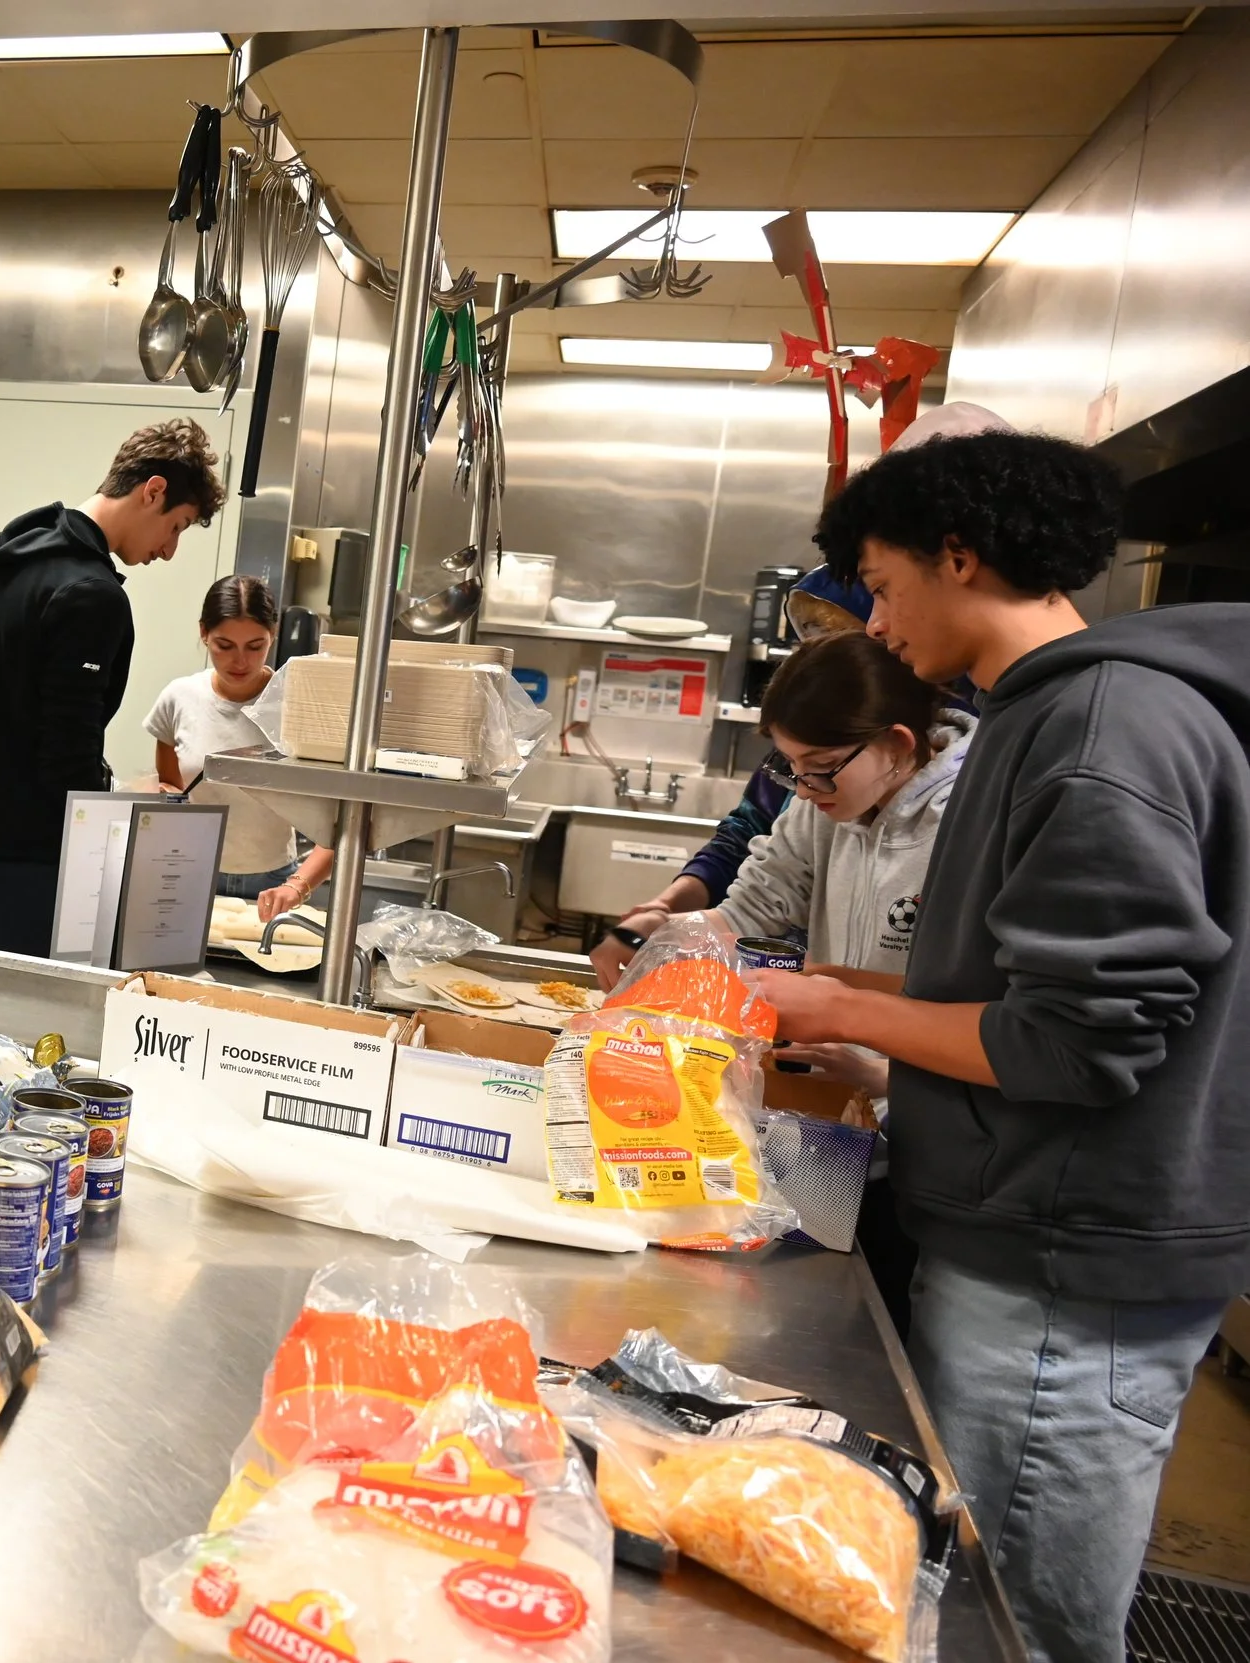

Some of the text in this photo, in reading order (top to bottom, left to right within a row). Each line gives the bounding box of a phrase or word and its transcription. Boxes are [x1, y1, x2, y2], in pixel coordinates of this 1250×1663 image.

[767, 957, 798, 969] GOYA
[134, 1014, 192, 1064] Silver
[353, 1041, 381, 1053] 899596
[221, 1045, 354, 1080] FOODSERVICE FILM
[219, 1062, 321, 1088] WITH LOW PROFILE METAL EDGE
[85, 1104, 100, 1115] YA
[419, 1147, 429, 1155] 08
[432, 1150, 455, 1160] 06795
[459, 1155, 482, 1166] 01905
[602, 1149, 688, 1161] missionfoods.com
[96, 1181, 114, 1189] GOYA
[458, 1578, 567, 1624] soft
